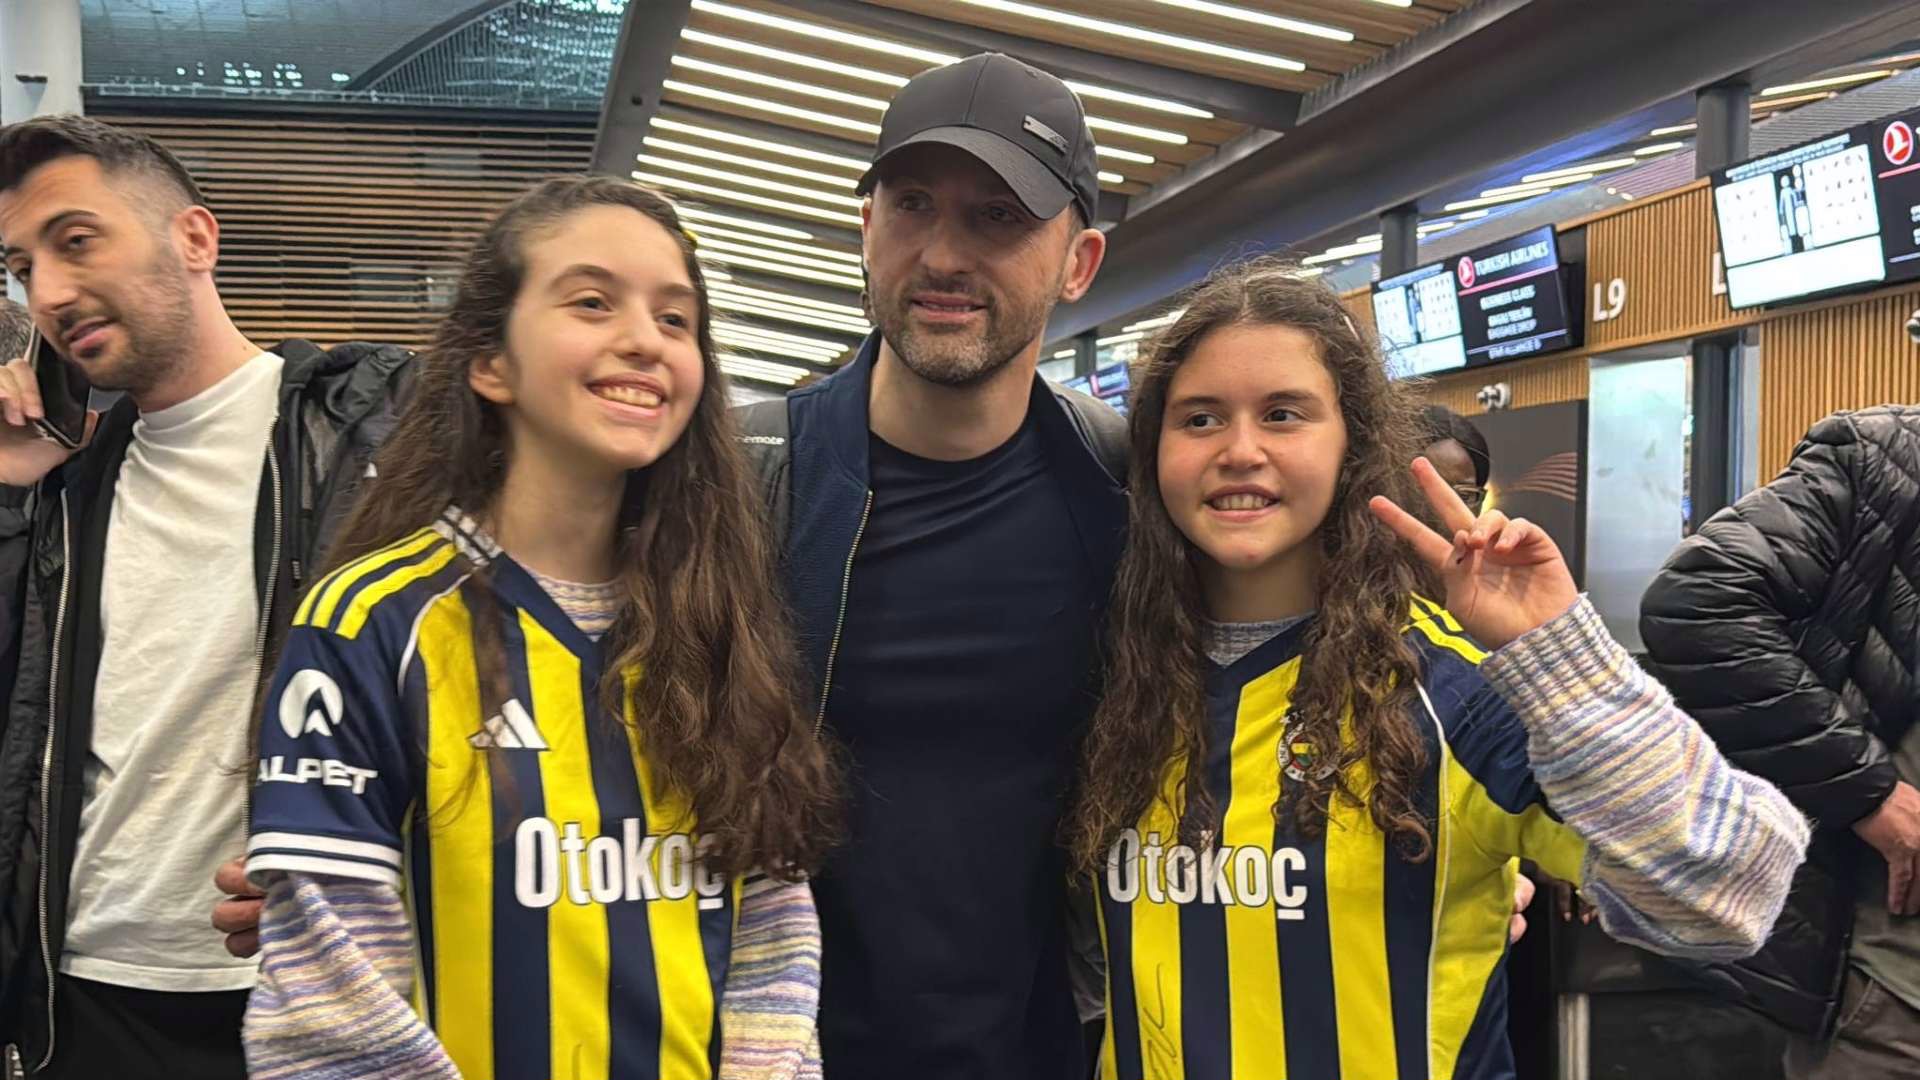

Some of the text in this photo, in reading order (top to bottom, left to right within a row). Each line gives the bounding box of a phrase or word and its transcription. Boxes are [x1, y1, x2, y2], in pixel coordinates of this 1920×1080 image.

[1510, 240, 1549, 266] AIRLINES
[1712, 251, 1727, 296] L
[1593, 278, 1625, 322] L9
[1106, 828, 1307, 920] Otokoç
